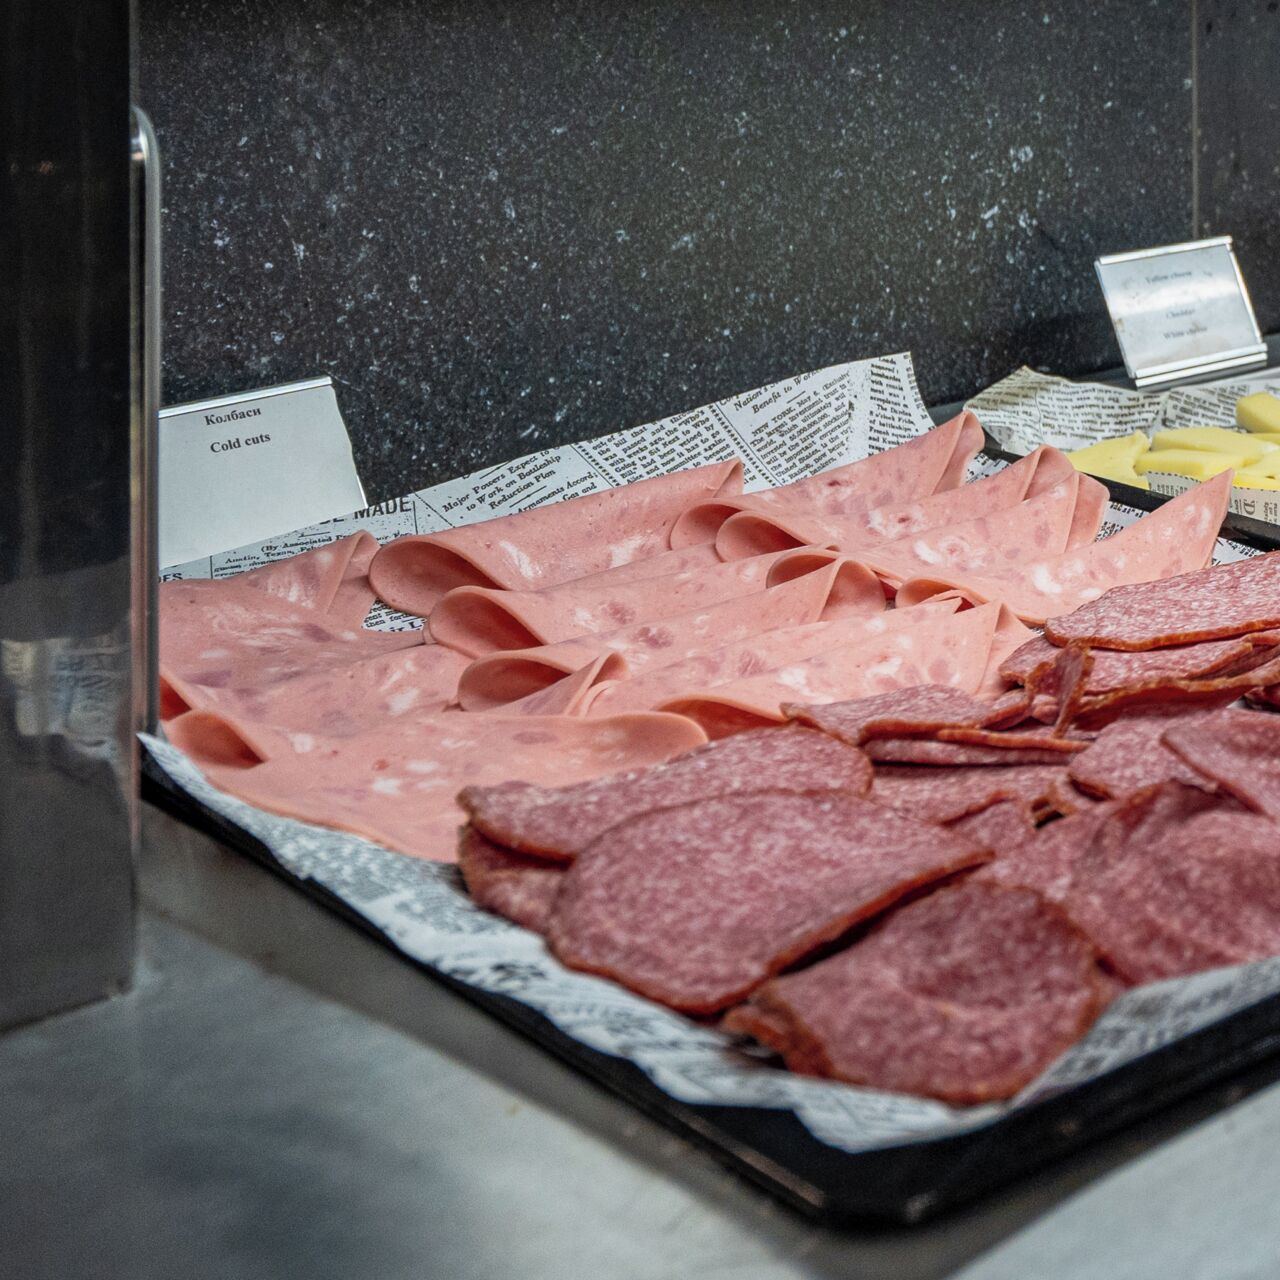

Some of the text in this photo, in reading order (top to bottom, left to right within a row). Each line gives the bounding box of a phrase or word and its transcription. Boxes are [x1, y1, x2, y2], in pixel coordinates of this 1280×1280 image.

[752, 386, 793, 414] Benefit to
[801, 402, 832, 423] ultimately
[204, 405, 262, 428] Колбаси
[750, 437, 764, 447] The
[765, 421, 788, 438] largest
[788, 398, 826, 422] investment
[823, 388, 839, 400] trust
[752, 422, 769, 437] NEW
[796, 396, 811, 408] May
[209, 431, 271, 455] Cold cuts
[598, 426, 648, 456] the bill that
[603, 424, 666, 462] was passed and
[607, 435, 616, 443] of
[609, 458, 626, 467] with
[626, 445, 648, 459] weeks
[665, 427, 679, 437] the
[615, 461, 637, 473] Going
[648, 447, 661, 456] Sit
[662, 436, 680, 448] Next
[692, 417, 710, 429] Who
[641, 458, 656, 469] had
[658, 448, 676, 459] been
[679, 431, 703, 447] vetoed
[704, 423, 714, 432] by
[703, 444, 731, 461] become
[760, 440, 787, 460] invested
[766, 427, 822, 465] will be the largest
[813, 452, 827, 464] now
[827, 440, 846, 454] being
[627, 474, 644, 485] Alice
[646, 465, 660, 475] and
[661, 457, 676, 467] now
[685, 443, 700, 453] has
[711, 430, 720, 439] go
[666, 452, 702, 474] committee
[770, 440, 817, 472] the important
[442, 448, 550, 512] Major Powers Expect to
[476, 486, 504, 504] Work
[505, 480, 517, 488] on
[517, 456, 561, 480] Battleship
[489, 470, 556, 510] Reduction Plan
[582, 483, 598, 495] and
[354, 499, 412, 520] MADE
[282, 536, 333, 549] Associated
